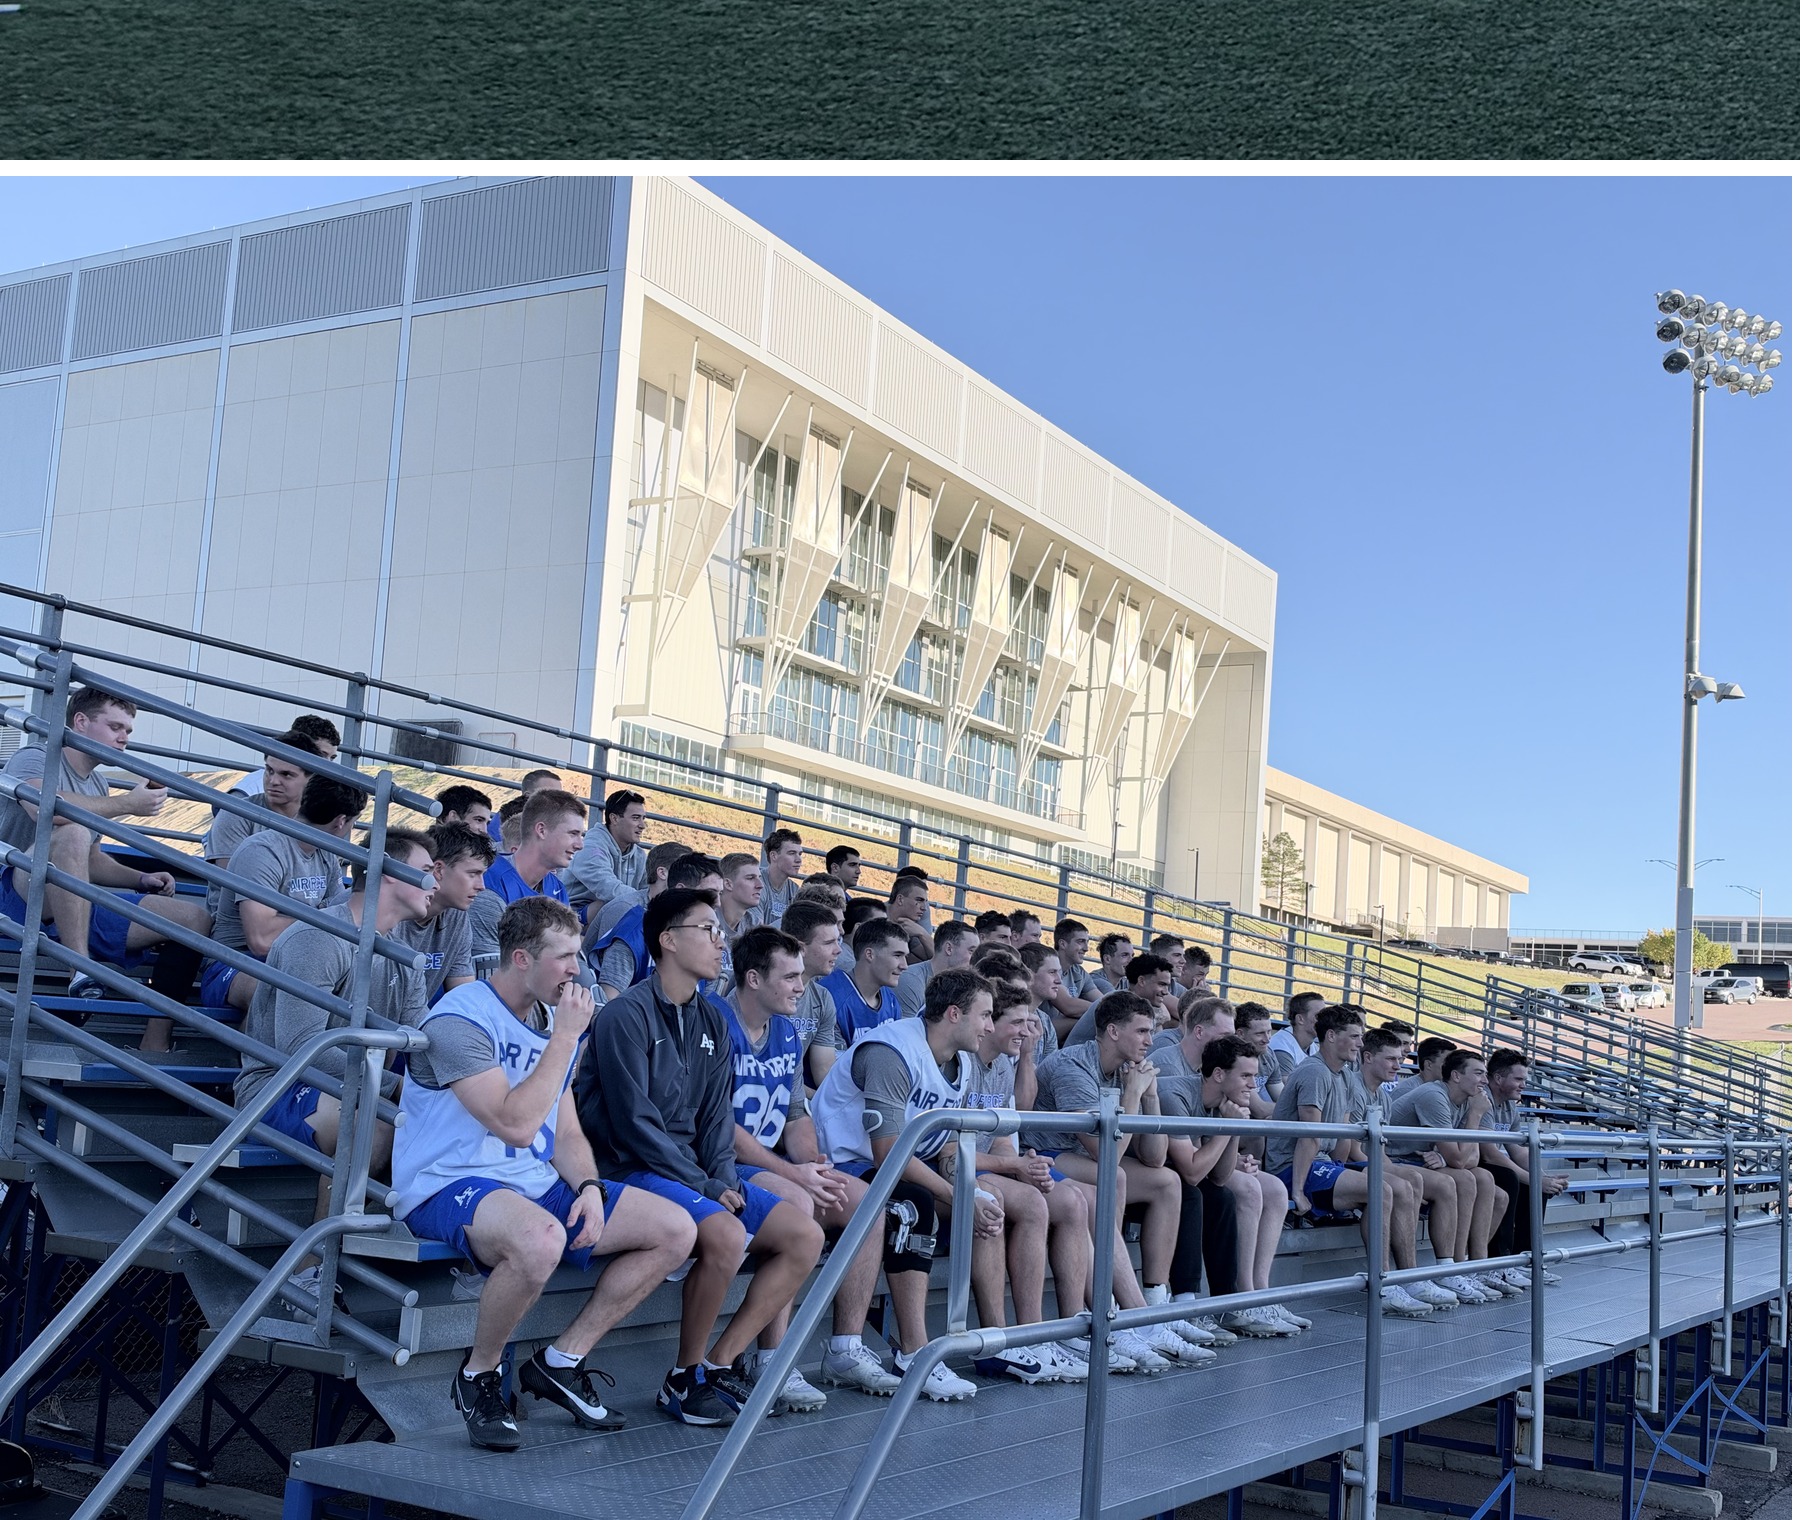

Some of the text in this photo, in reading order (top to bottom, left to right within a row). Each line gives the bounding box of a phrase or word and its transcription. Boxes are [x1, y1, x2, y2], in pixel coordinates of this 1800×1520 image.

[498, 1042, 522, 1069] AR
[700, 1033, 715, 1056] AF
[733, 1052, 797, 1079] AIR FORCE
[909, 1087, 939, 1110] AIR
[731, 1083, 792, 1149] 36
